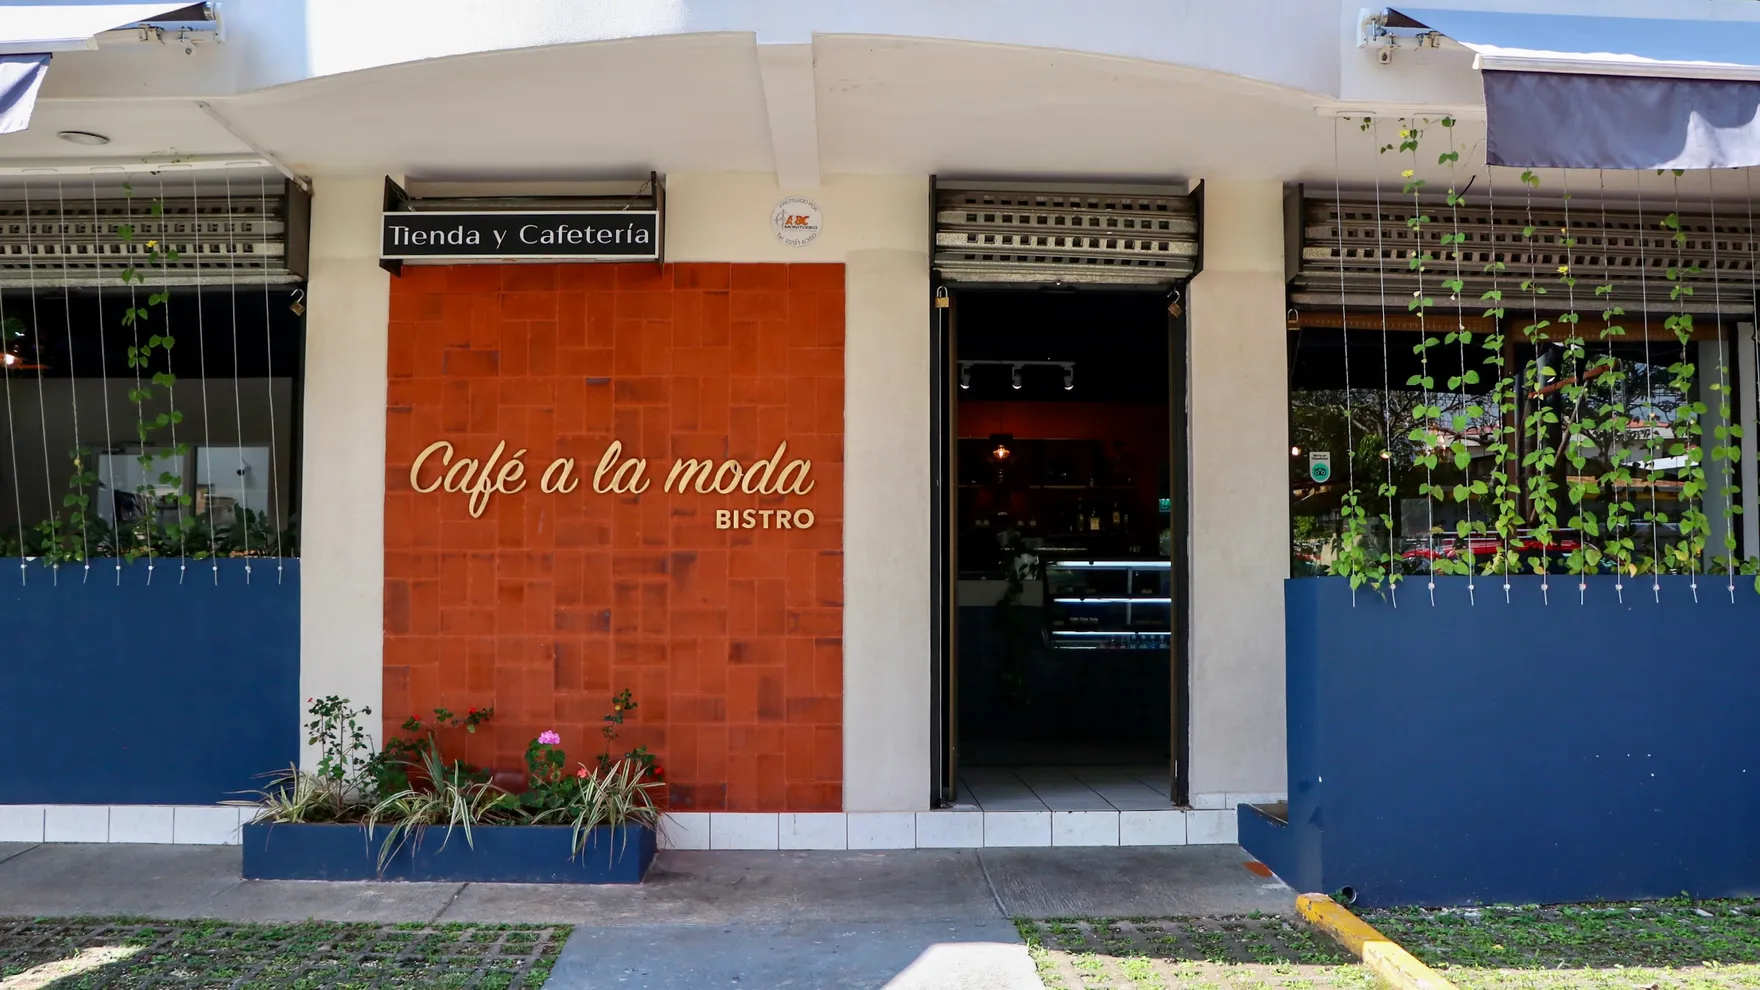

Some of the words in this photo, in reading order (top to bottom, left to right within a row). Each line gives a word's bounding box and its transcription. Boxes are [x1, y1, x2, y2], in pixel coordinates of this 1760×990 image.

[785, 215, 809, 225] ABC
[388, 225, 480, 245] Tienda
[493, 229, 507, 249] y
[519, 222, 649, 244] Cafetería
[409, 439, 527, 519] Café
[540, 457, 578, 495] a
[592, 439, 650, 495] la
[663, 440, 815, 495] moda
[715, 508, 815, 530] BISTRO
